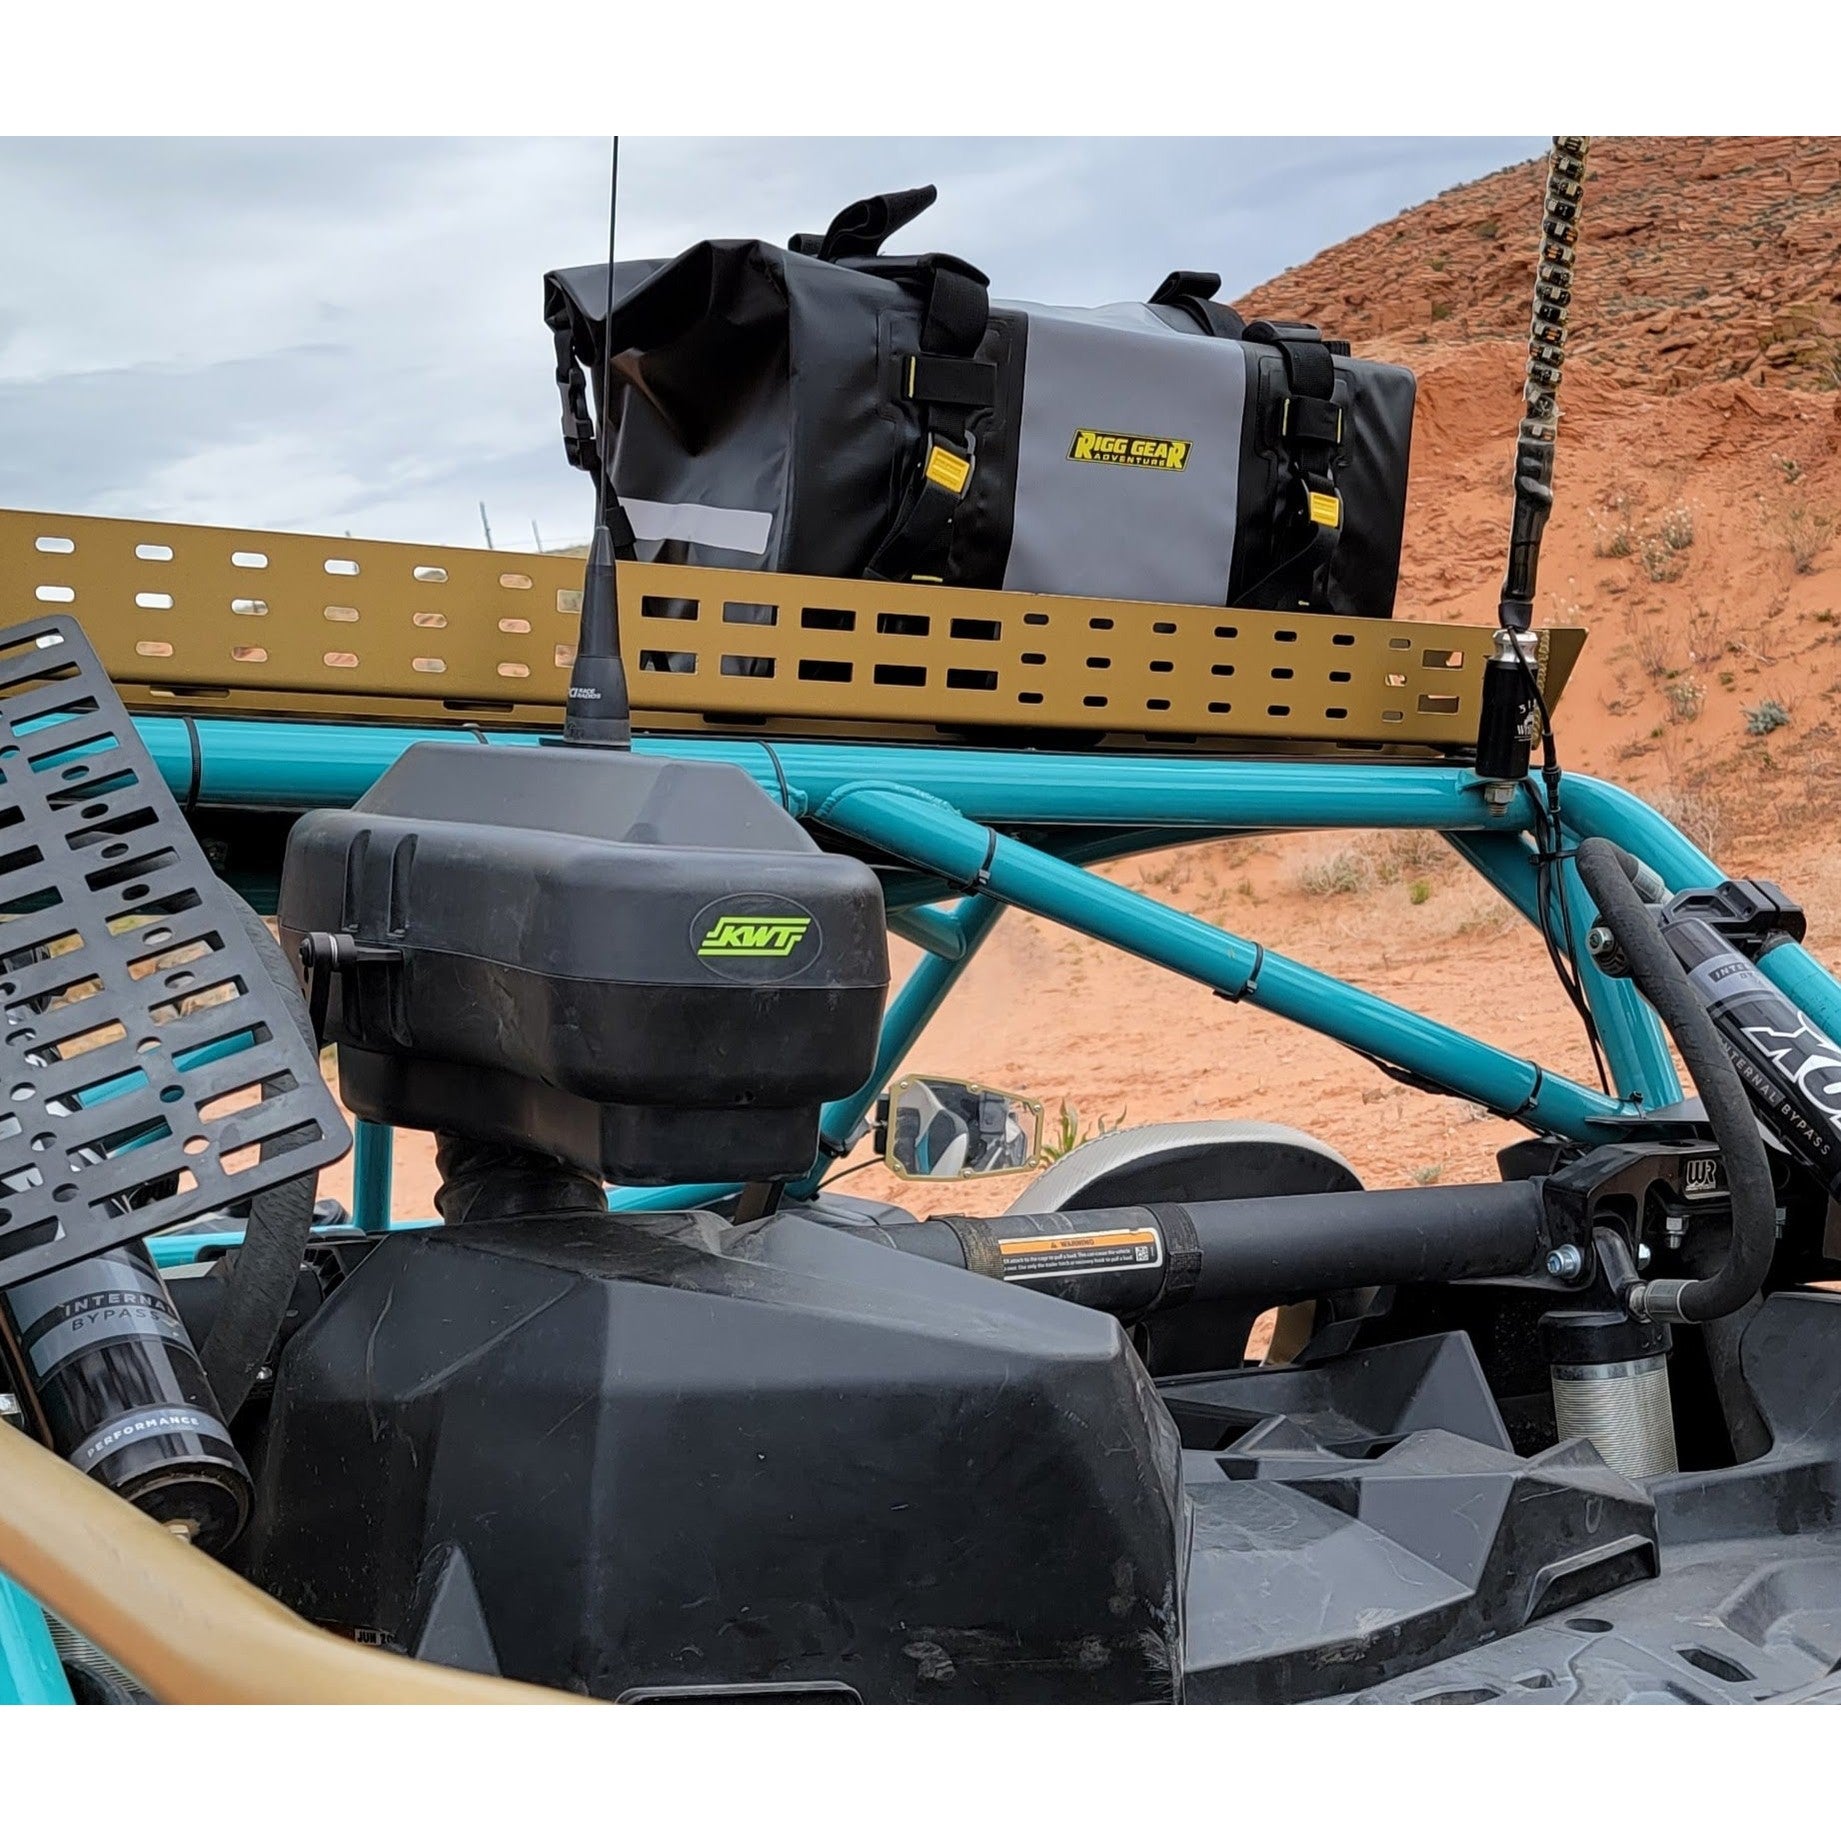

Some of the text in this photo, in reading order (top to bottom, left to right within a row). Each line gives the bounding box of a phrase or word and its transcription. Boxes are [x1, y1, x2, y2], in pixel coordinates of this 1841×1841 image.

[1074, 432, 1186, 469] RIGG GEAR
[1093, 453, 1166, 467] ADVENTURE
[702, 921, 807, 951] KWT
[1781, 1103, 1831, 1155] BYPASS
[1060, 1239, 1095, 1247] WARNING
[71, 1308, 160, 1331] BYPASS
[87, 1416, 200, 1458] PERFORMANCE
